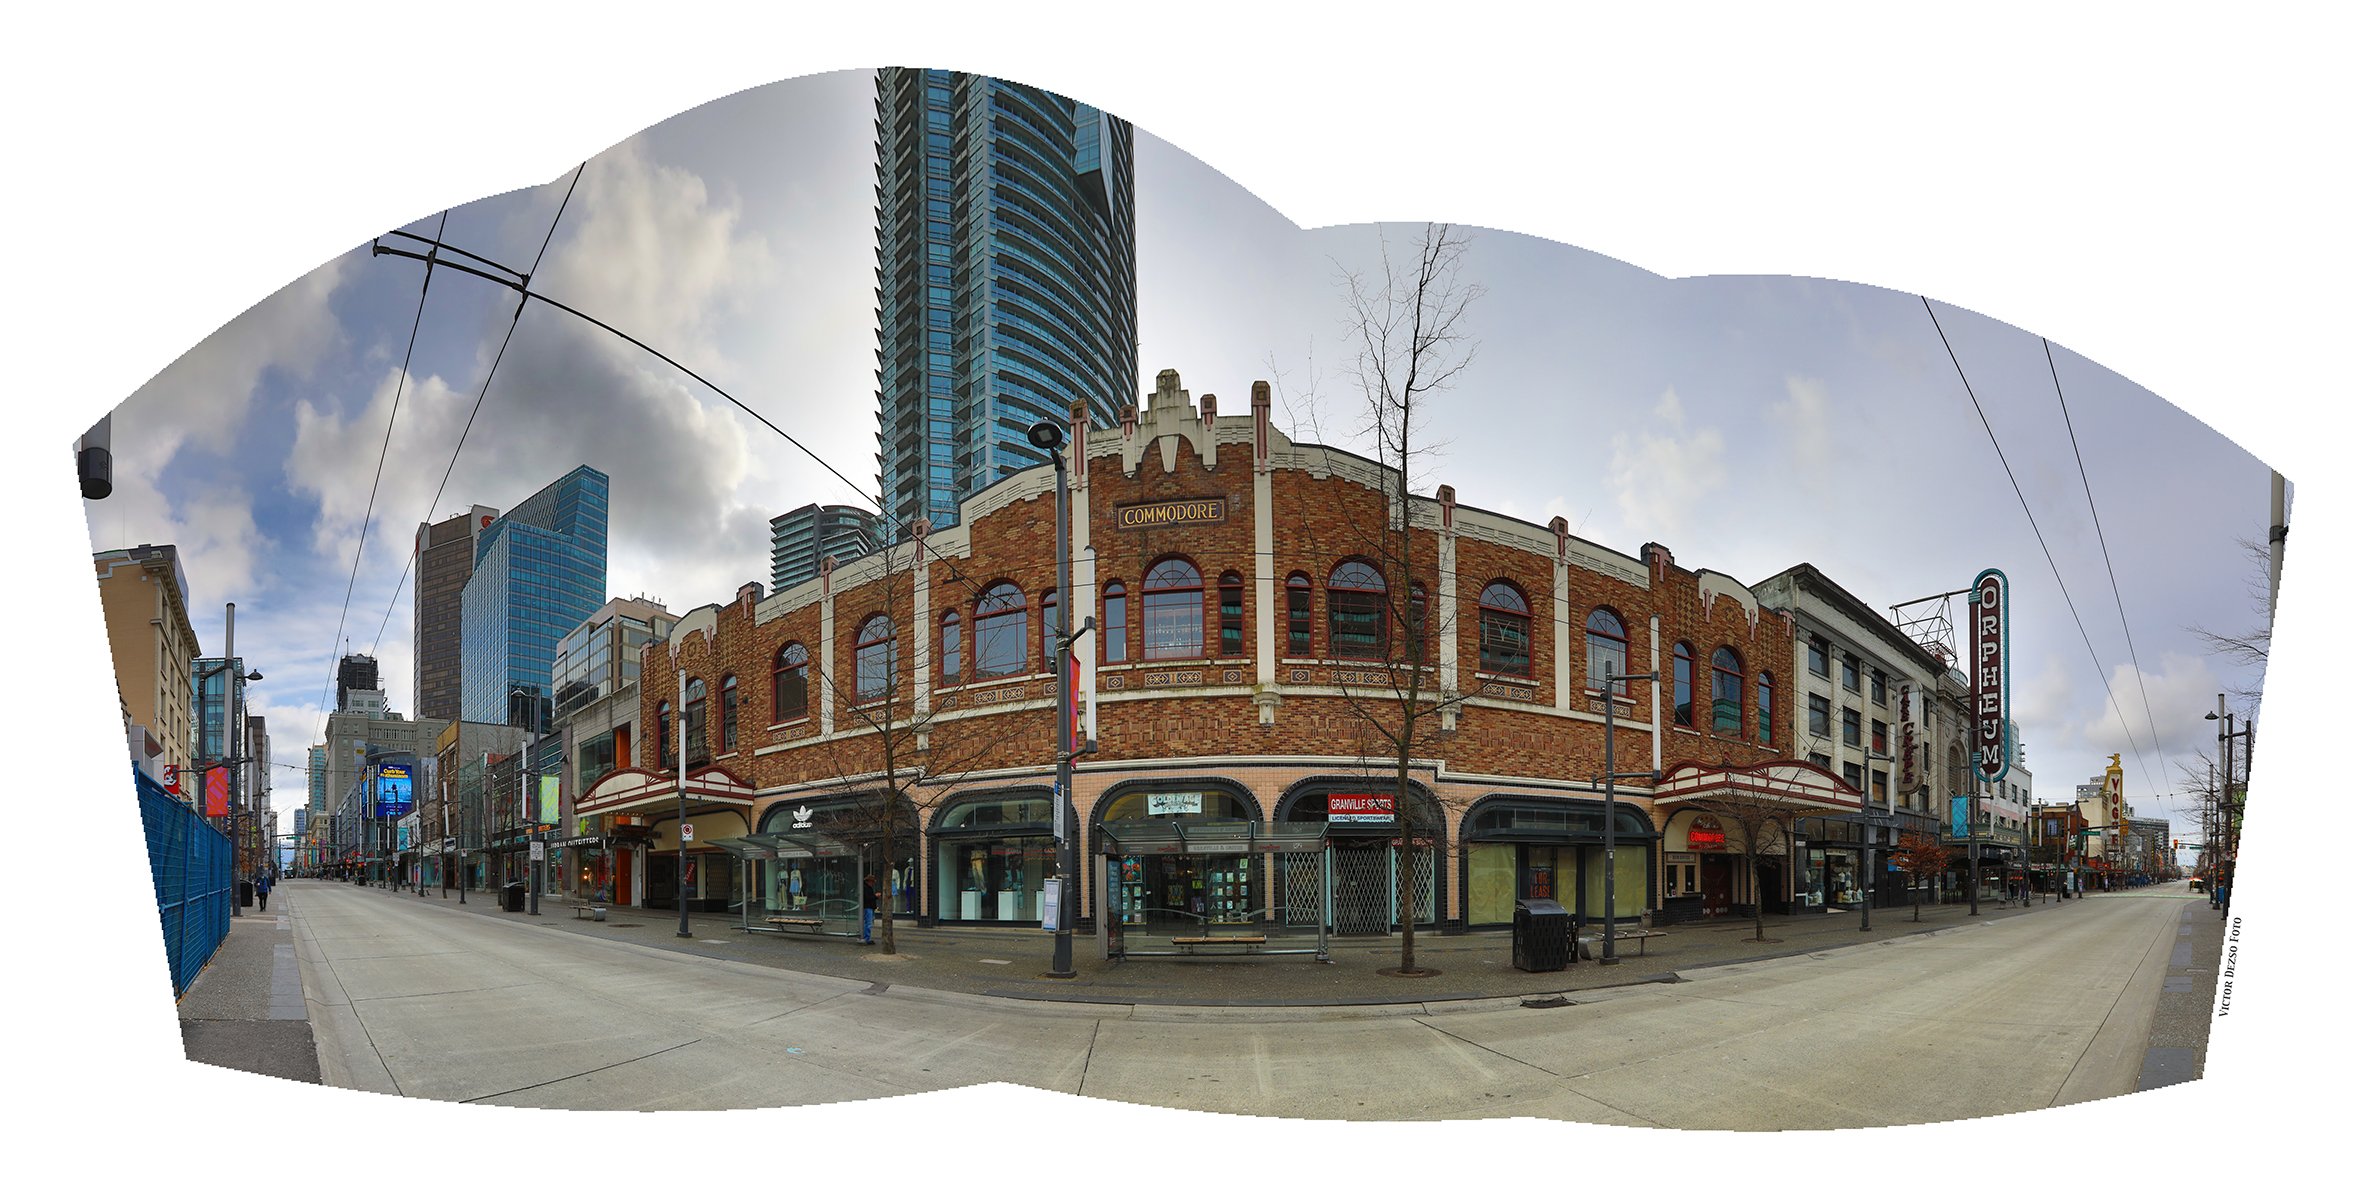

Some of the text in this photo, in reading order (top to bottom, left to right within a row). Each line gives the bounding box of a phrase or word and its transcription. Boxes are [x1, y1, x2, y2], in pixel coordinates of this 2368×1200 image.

[1124, 503, 1218, 525] COMMODORE
[1981, 586, 1998, 764] ORPHEUM
[1331, 798, 1392, 810] GRANVILLE SPORTS
